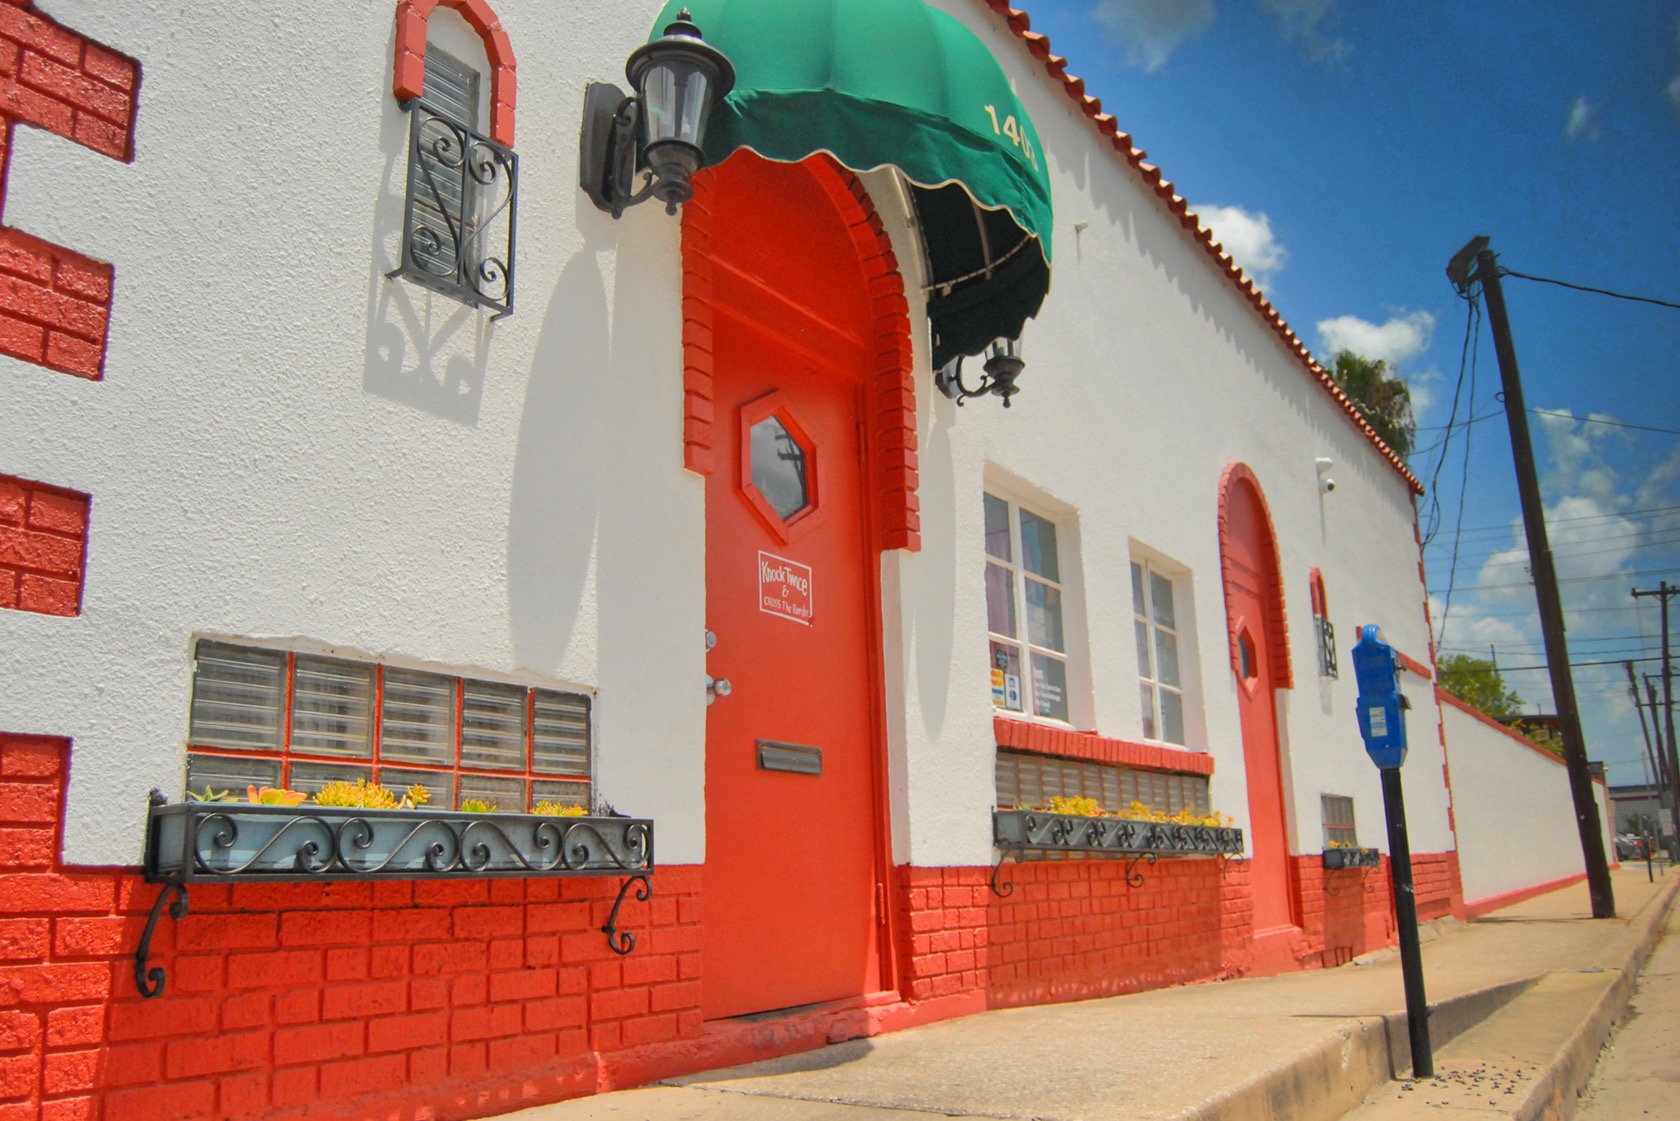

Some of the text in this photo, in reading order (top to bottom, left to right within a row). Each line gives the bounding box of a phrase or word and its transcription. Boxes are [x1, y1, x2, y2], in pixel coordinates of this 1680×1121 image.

[762, 561, 808, 596] Knock Twice
[781, 584, 789, 598] &
